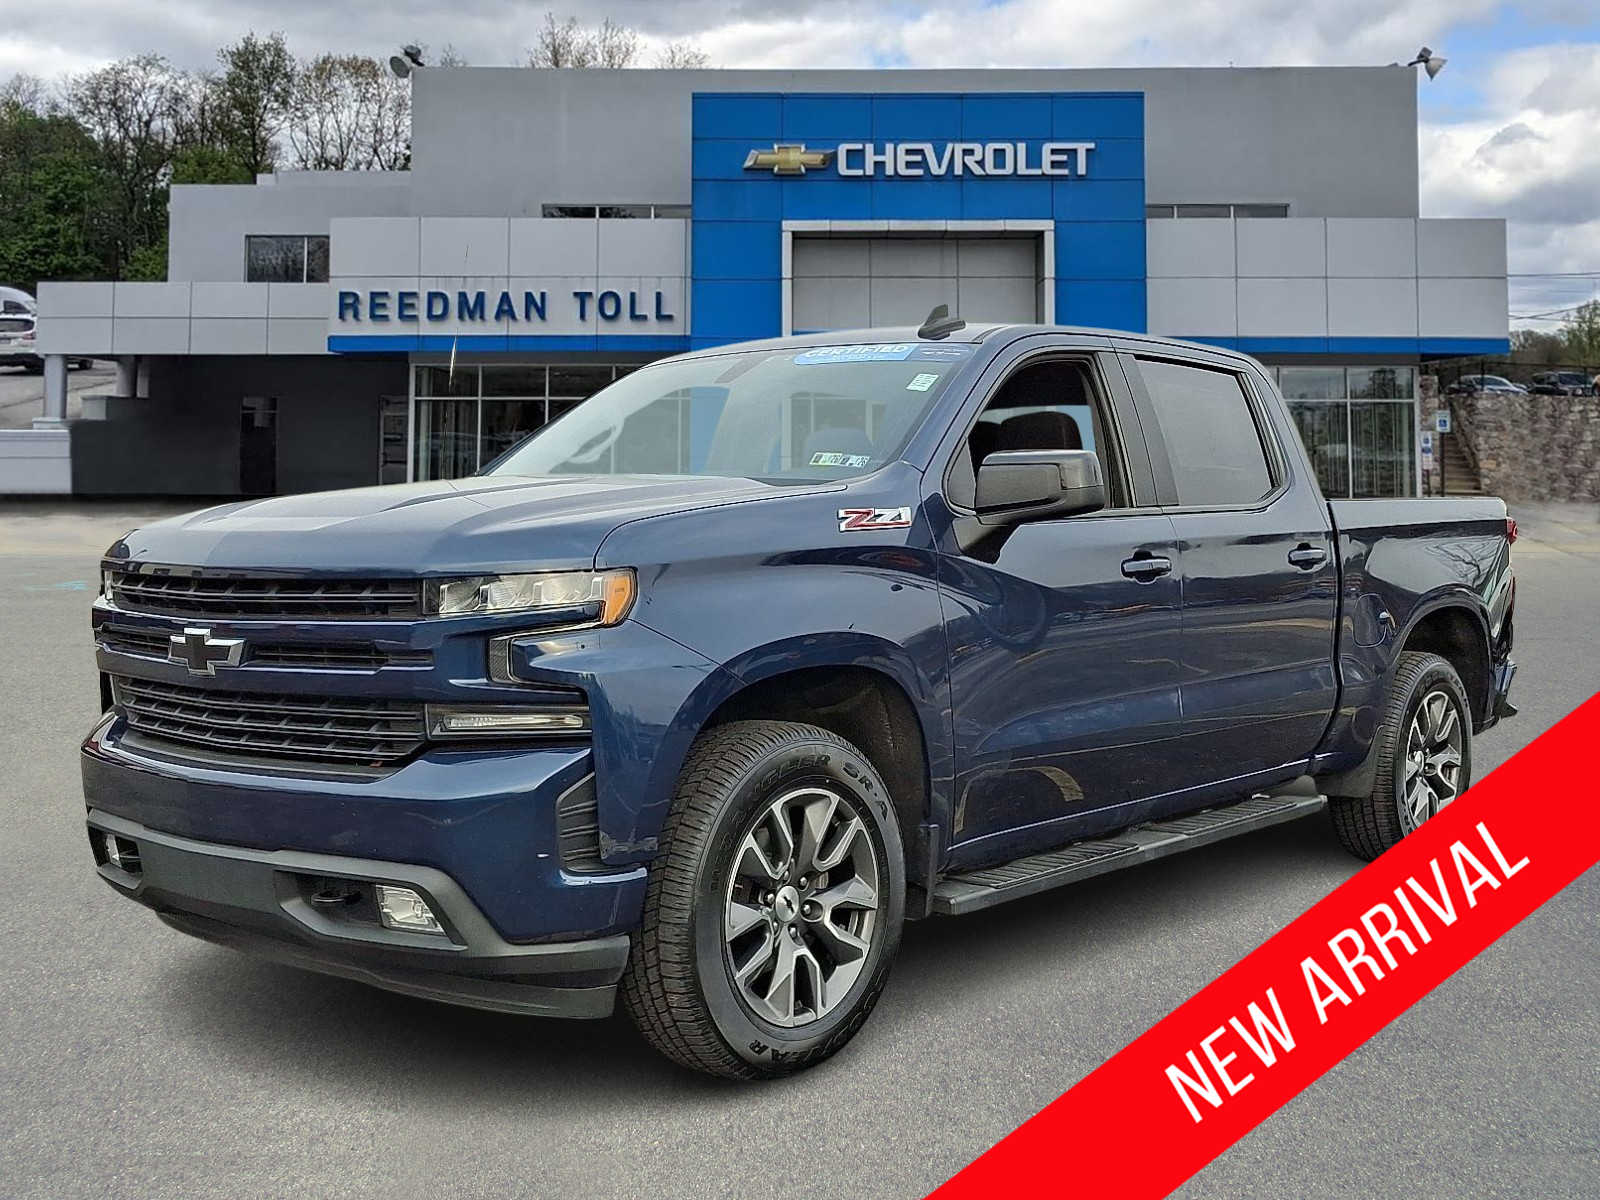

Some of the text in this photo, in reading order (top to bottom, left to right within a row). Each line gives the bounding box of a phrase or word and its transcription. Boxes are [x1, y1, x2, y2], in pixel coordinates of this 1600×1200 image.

[836, 141, 1096, 177] CHEVROLET
[338, 290, 674, 322] REEDMAN TOLL
[806, 345, 908, 358] CERTIFIED
